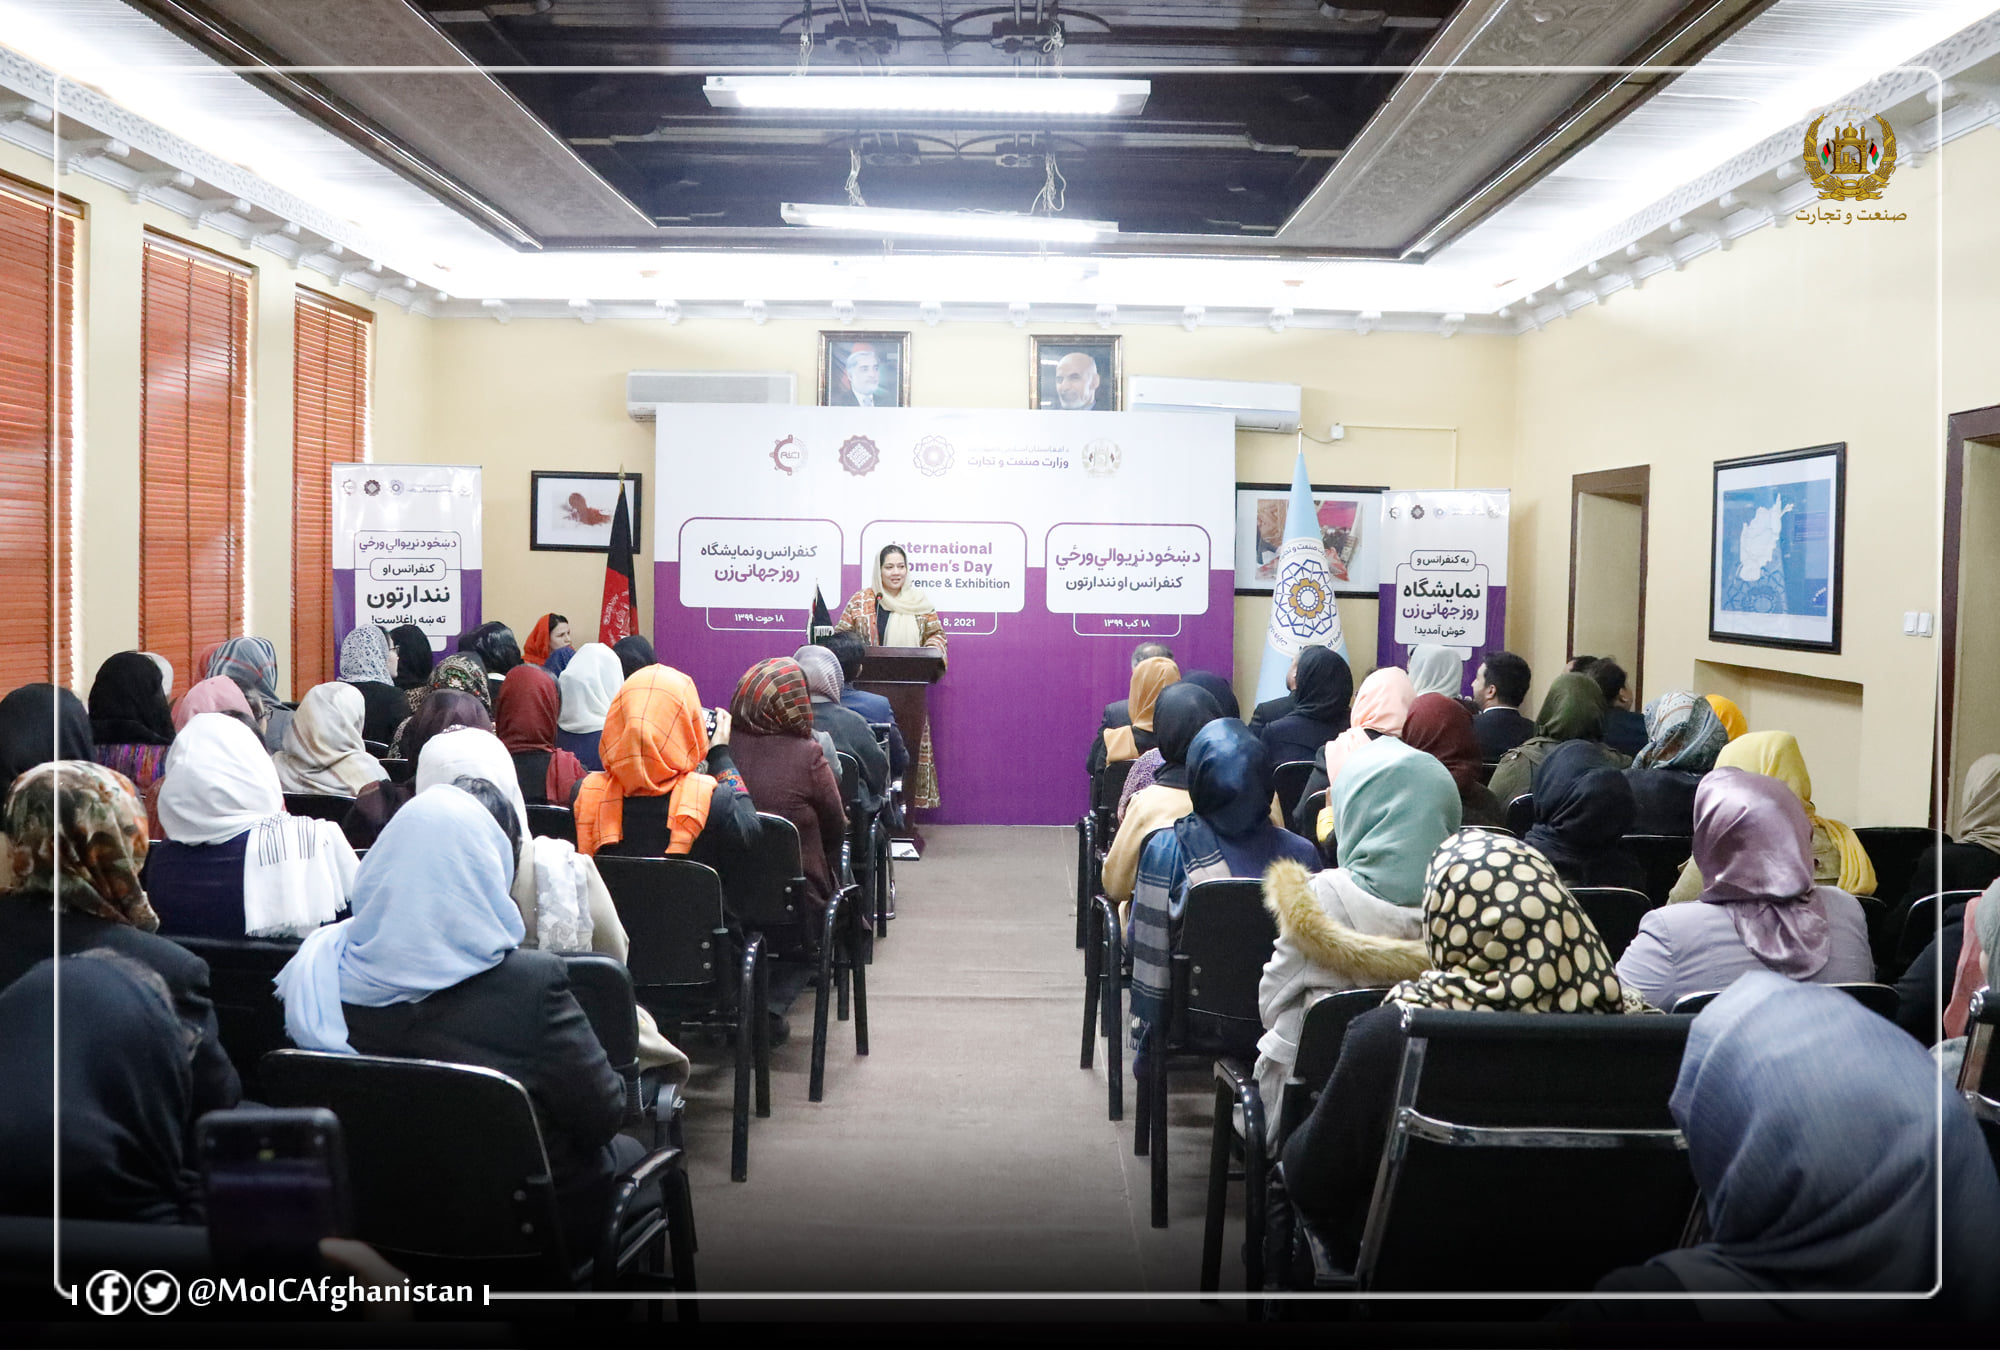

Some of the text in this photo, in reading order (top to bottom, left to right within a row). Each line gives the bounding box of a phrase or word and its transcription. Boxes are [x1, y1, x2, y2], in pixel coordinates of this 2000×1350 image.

[998, 458, 1005, 468] و
[1006, 457, 1040, 466] صنعت
[1041, 457, 1069, 469] وزارت
[701, 541, 818, 560] کنفرانس و نمایشگاه
[1416, 554, 1470, 567] به کنفرانس و
[382, 563, 435, 576] کنفرانس او
[715, 563, 800, 582] روز جهانی زن
[964, 561, 993, 576] Day
[944, 578, 953, 588] &
[955, 578, 1010, 589] Exhibition
[1065, 576, 1183, 592] کنفرانس او نندارتون
[1403, 577, 1481, 603] نمایشگاه
[366, 585, 450, 609] نندارتون
[1402, 602, 1479, 620] روز جهانی زن
[436, 615, 446, 624] ته
[953, 618, 976, 627] 2021
[1441, 627, 1466, 638] خوش
